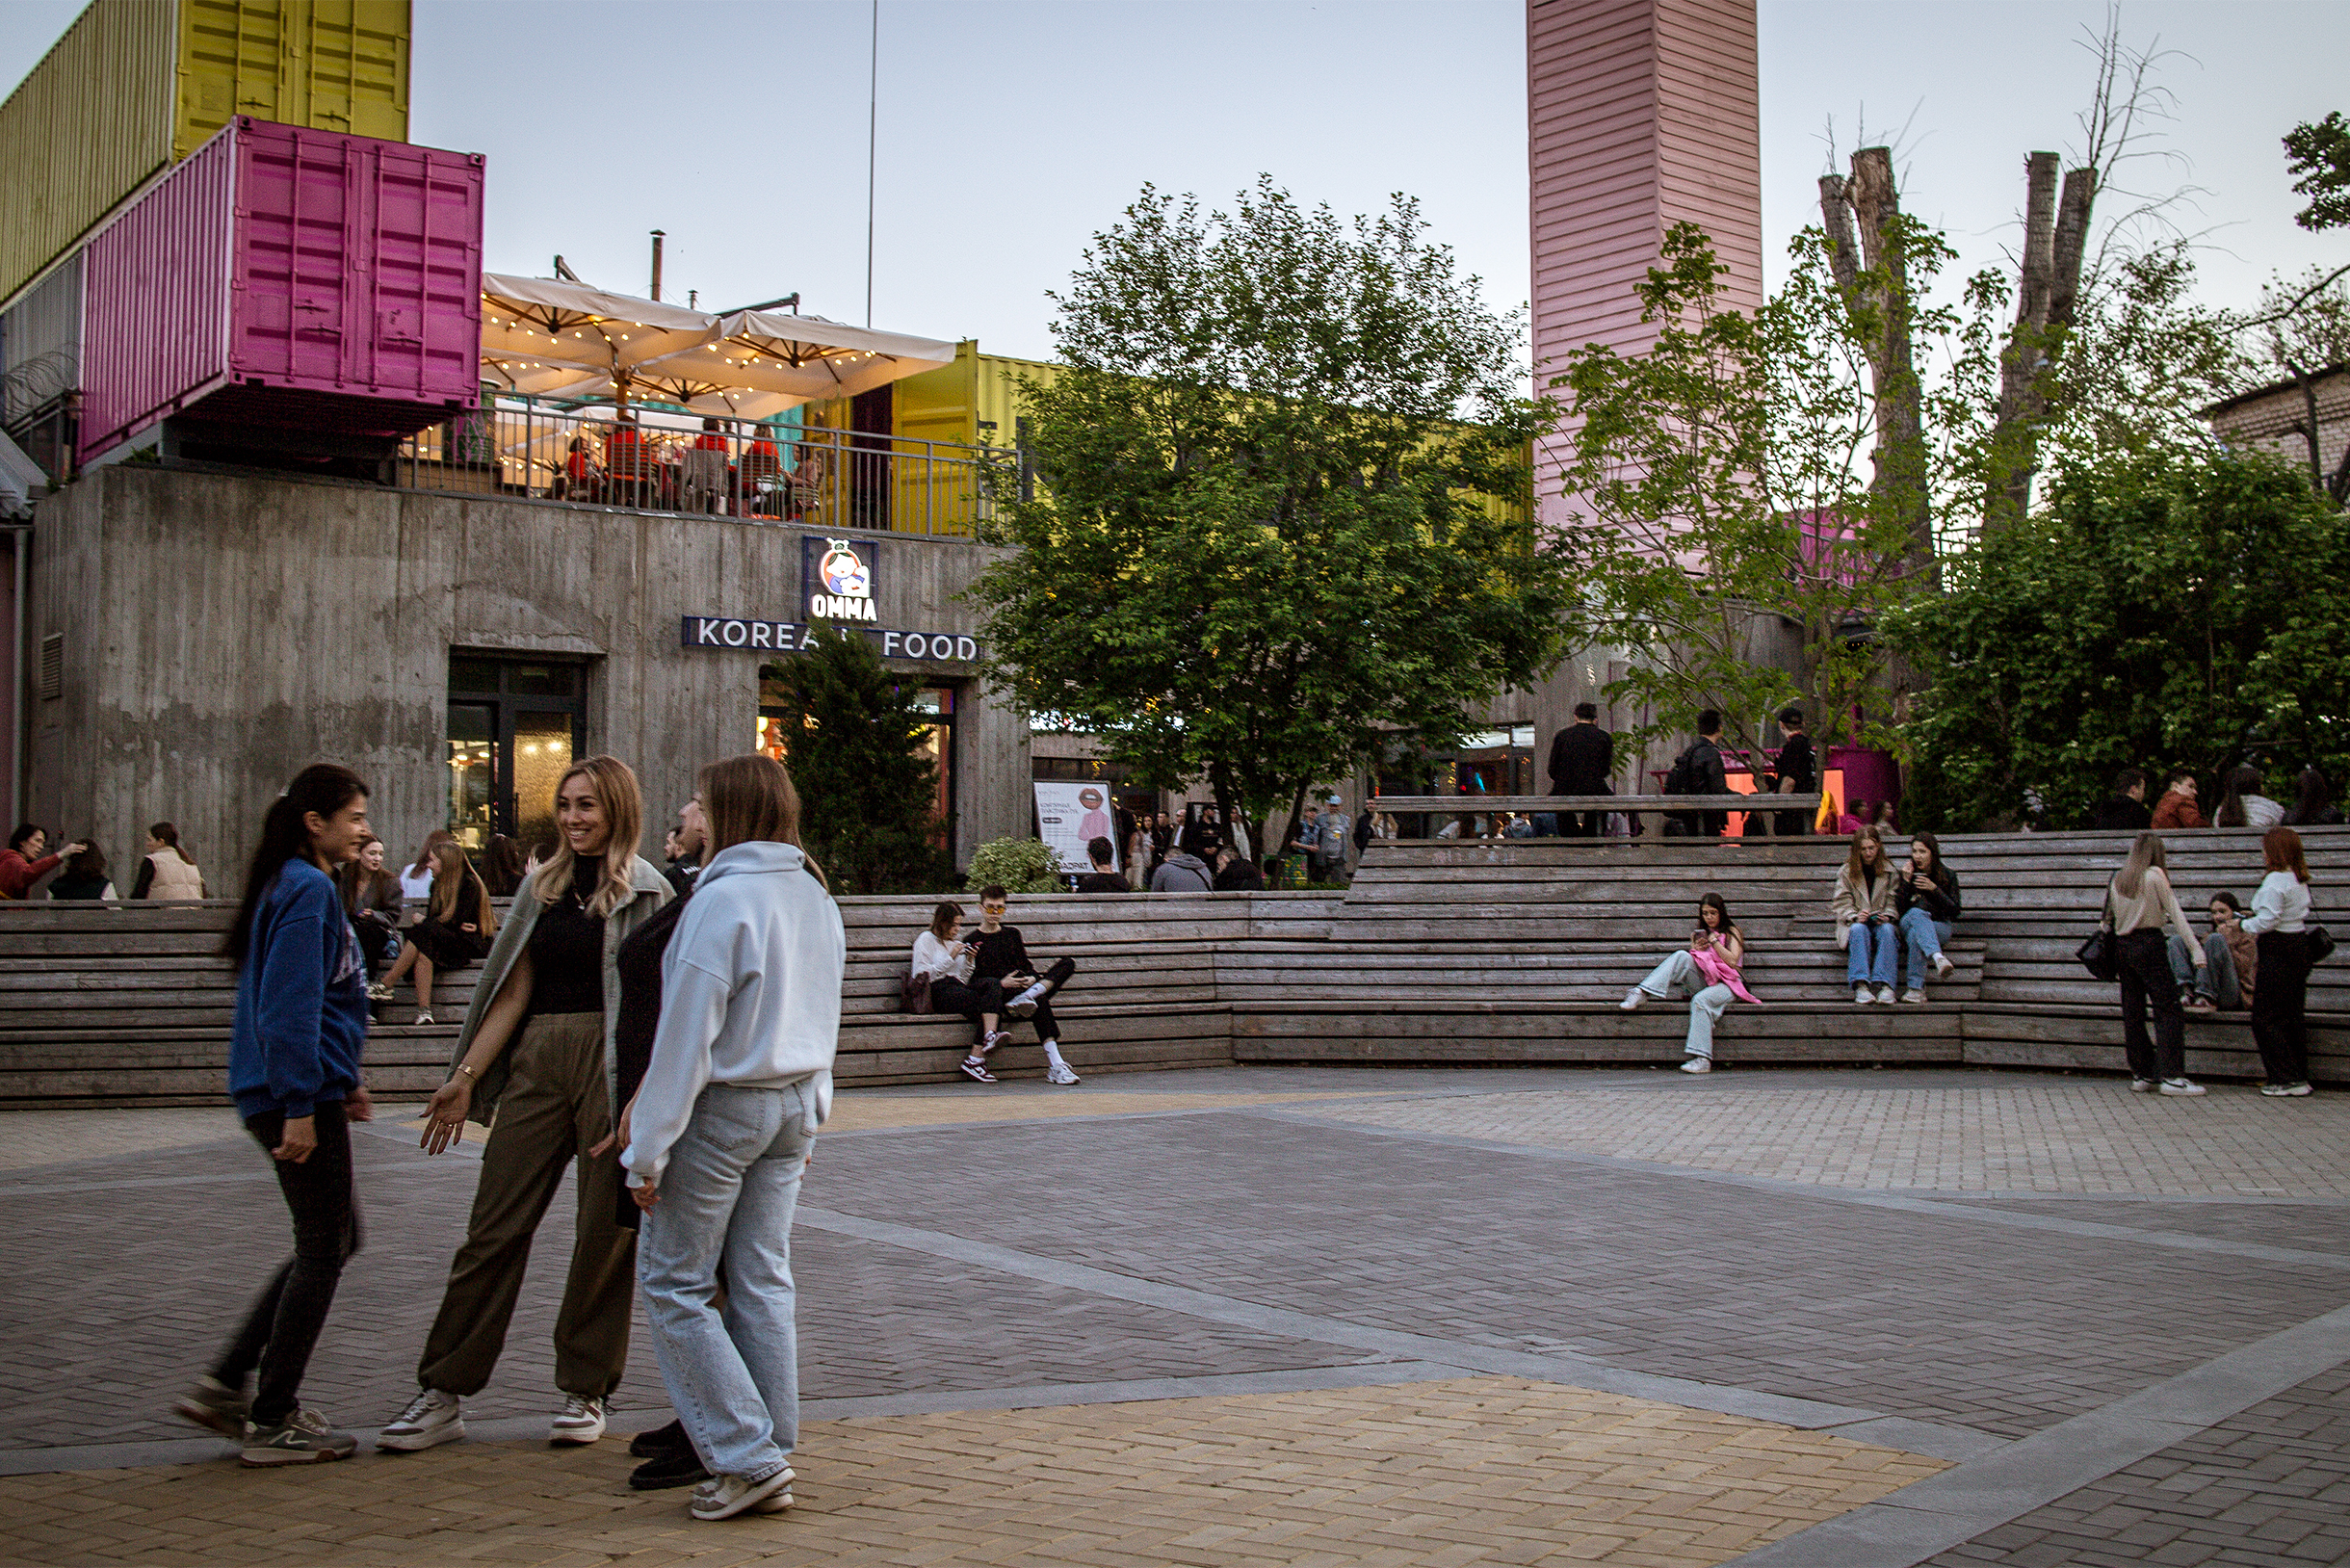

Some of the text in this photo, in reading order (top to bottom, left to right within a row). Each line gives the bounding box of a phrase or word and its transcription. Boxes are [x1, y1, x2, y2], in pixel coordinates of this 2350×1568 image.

[812, 594, 877, 621] OMMA
[698, 617, 978, 661] KOREA FOOD
